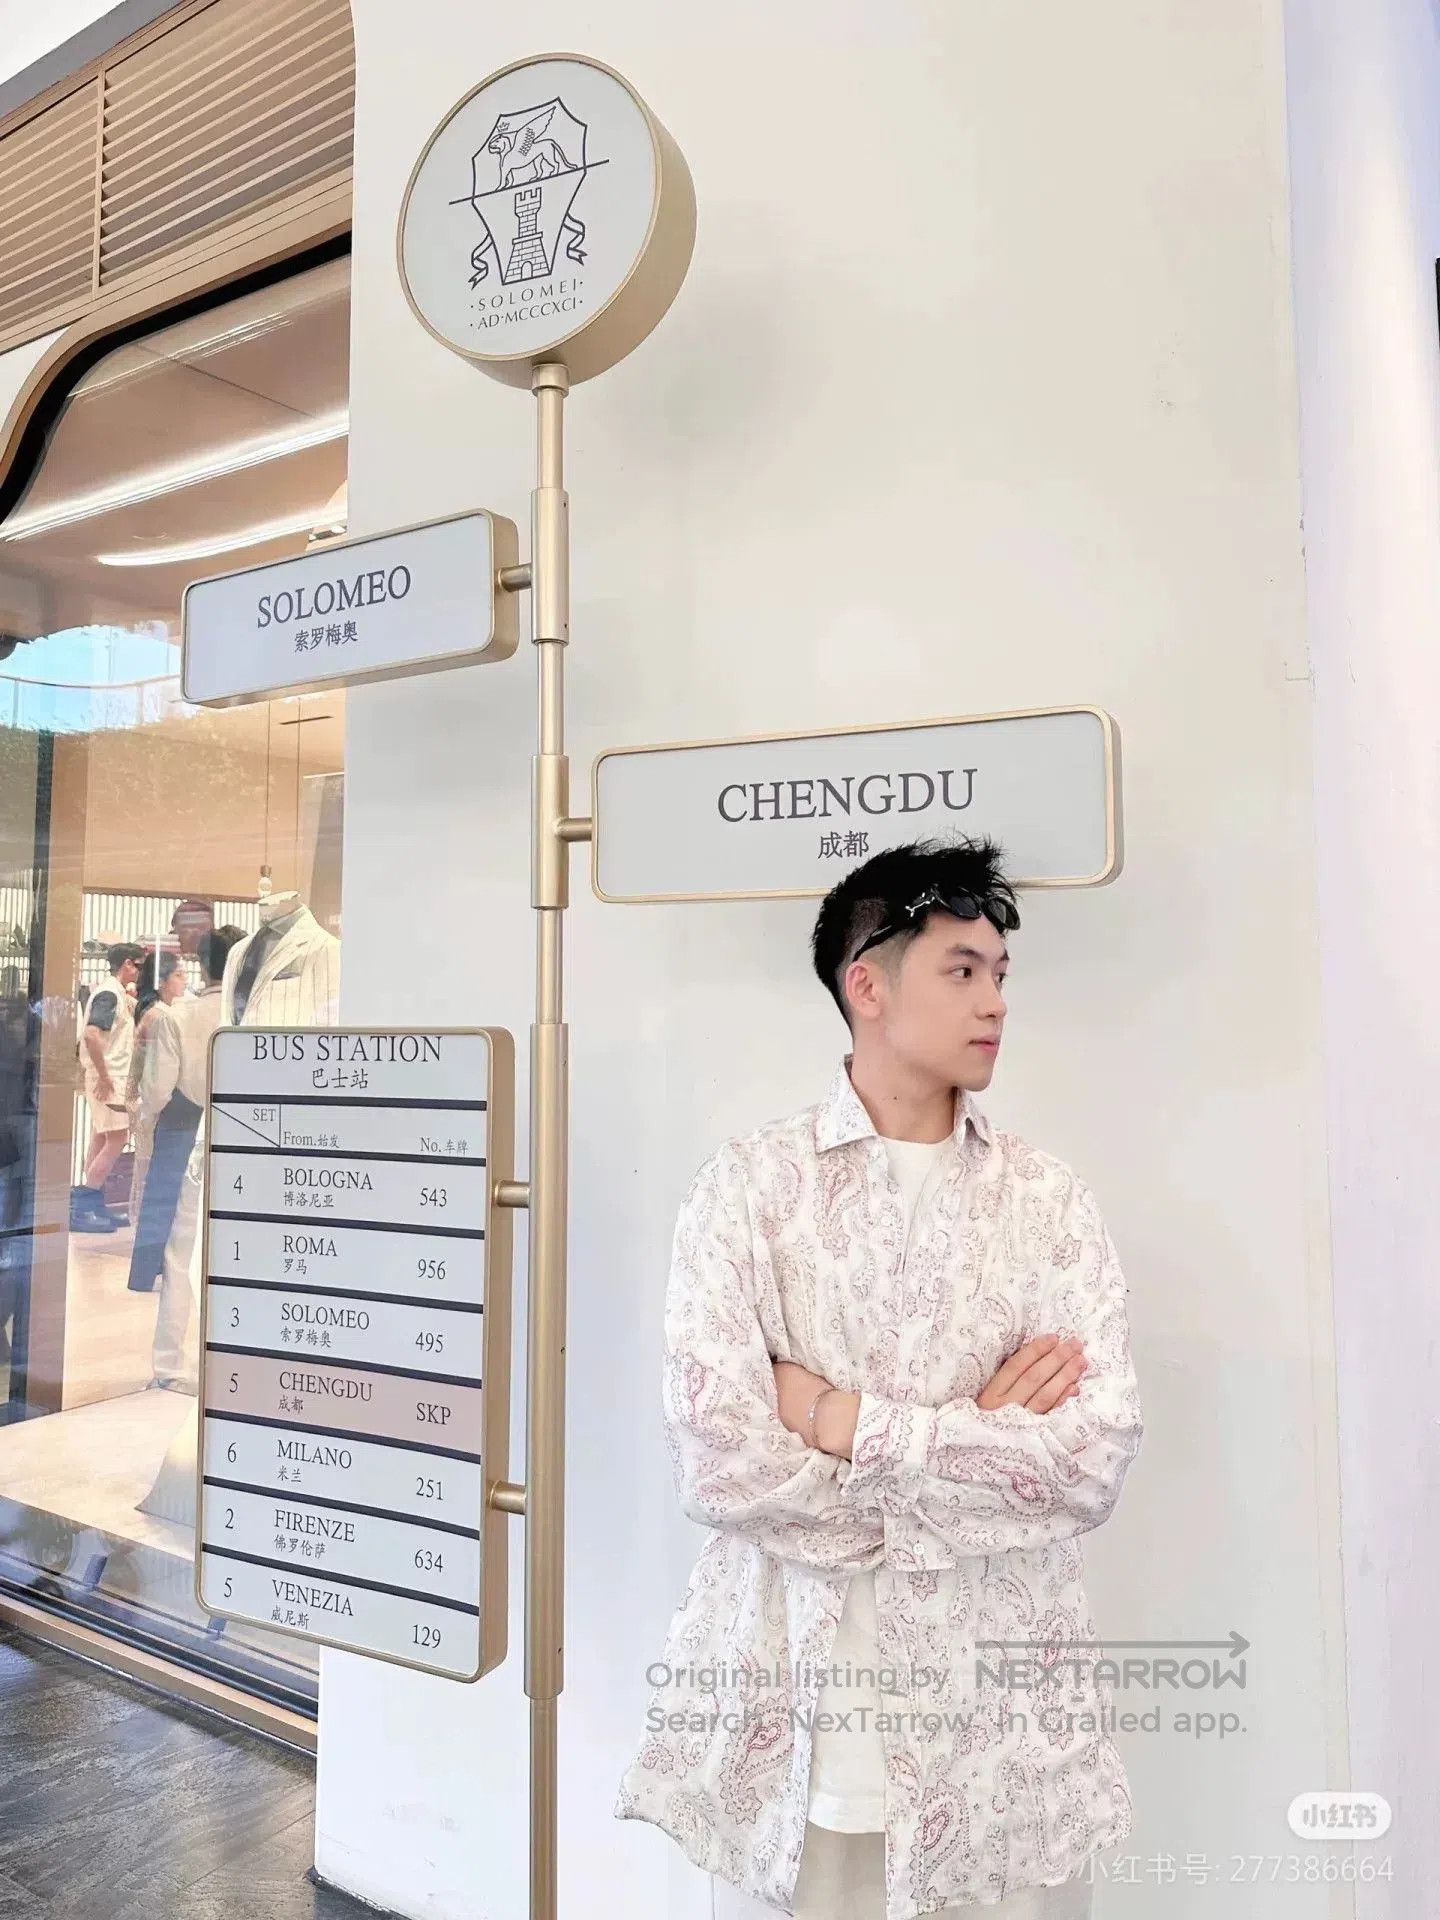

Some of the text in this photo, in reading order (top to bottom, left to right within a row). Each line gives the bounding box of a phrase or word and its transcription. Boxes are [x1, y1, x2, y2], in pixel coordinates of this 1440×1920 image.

[256, 565, 411, 627] SOLOMEO
[294, 620, 358, 653] 索罗梅奥
[718, 769, 977, 822] CHENGDU
[817, 830, 869, 859] 成都
[252, 1035, 443, 1062] BUS STATION
[313, 1068, 368, 1089] 巴士站
[254, 1109, 275, 1121] SET
[234, 1168, 447, 1207] 4 BOLOGNA 543
[234, 1236, 445, 1279] 1 ROMA 956
[284, 1259, 307, 1274] 罗马
[231, 1303, 443, 1353] 3 SOLOMEO 495
[281, 1328, 331, 1347] 索罗梅奥
[230, 1372, 450, 1425] 5 CHENGDU SKP
[279, 1395, 303, 1413] 成都
[228, 1440, 443, 1500] 6 MILANO 251
[278, 1465, 301, 1482] 米兰
[225, 1509, 443, 1572] 2 FIRENZE 634
[224, 1578, 440, 1648] 5 VENEZIA 129
[270, 1605, 310, 1630] 威尼斯
